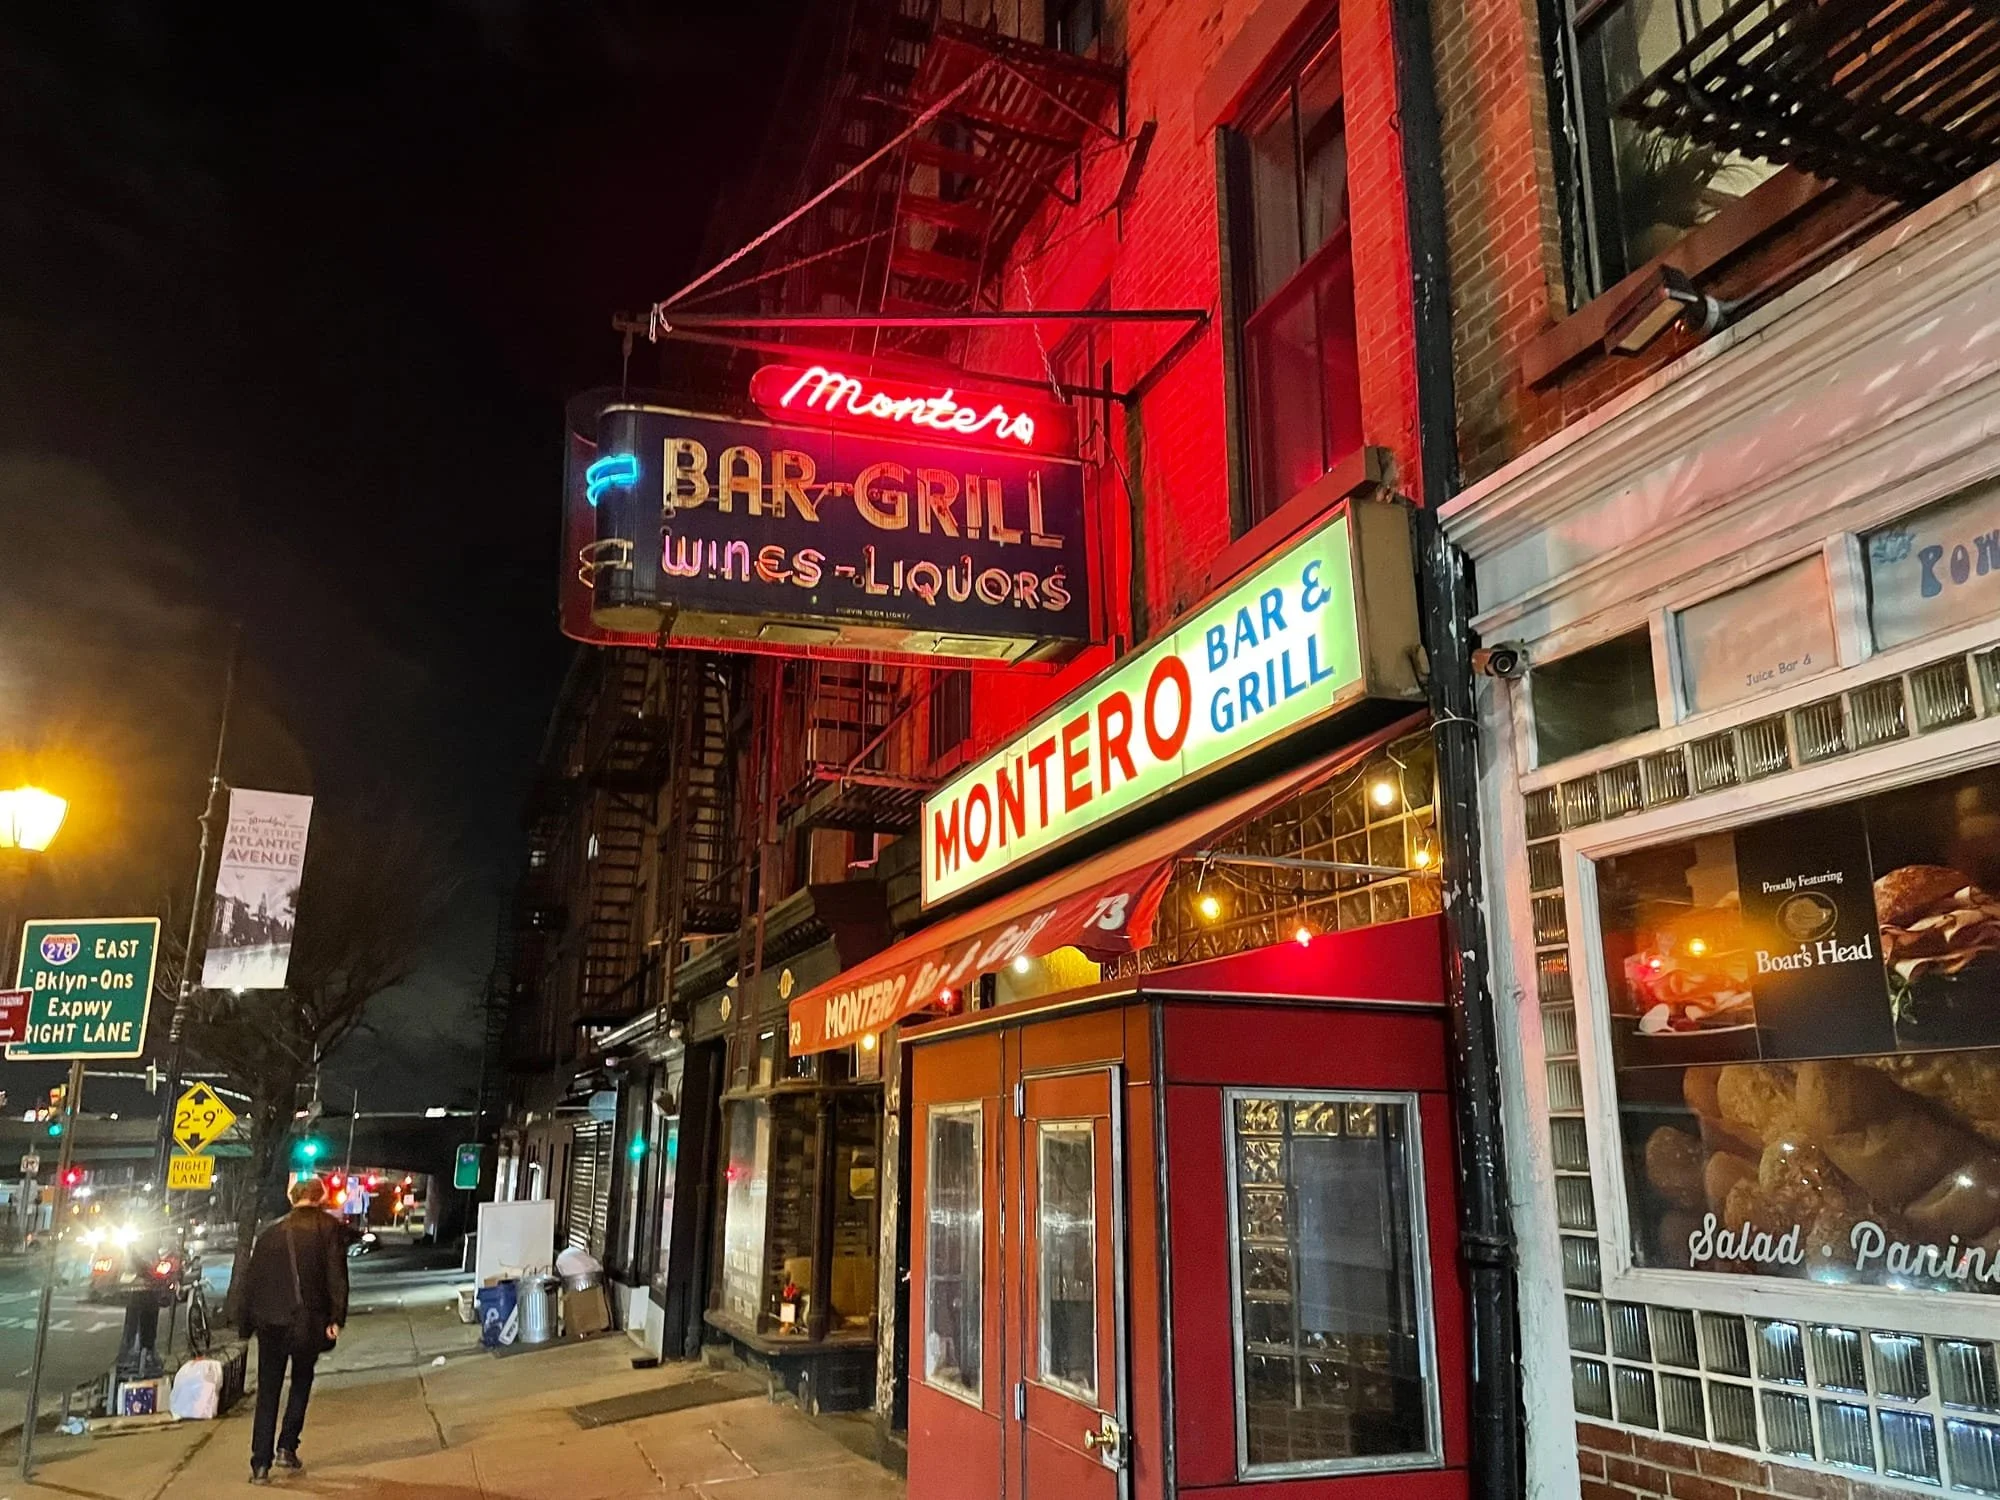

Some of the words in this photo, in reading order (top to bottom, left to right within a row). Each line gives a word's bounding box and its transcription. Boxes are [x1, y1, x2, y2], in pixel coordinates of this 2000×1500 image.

[780, 366, 1035, 444] Montero
[864, 544, 1071, 611] LIQUORS
[1205, 588, 1288, 673] BAR
[1302, 560, 1332, 612] &
[1210, 634, 1335, 733] GRILL
[1746, 670, 1774, 686] Juice
[1778, 660, 1798, 674] Bar
[934, 655, 1192, 882] MONTERO
[228, 835, 302, 852] ATLANTIC
[226, 848, 300, 867] AVENUE
[1762, 877, 1797, 893] Proudly
[1798, 870, 1843, 886] Featuring
[47, 943, 73, 959] 278
[95, 938, 139, 959] EAST
[1755, 944, 1813, 974] Boar's
[1815, 933, 1873, 965] Head
[825, 975, 907, 1040] MONTERO
[1083, 893, 1130, 930] 73
[35, 969, 134, 995] Bklyn-Qns
[48, 997, 112, 1020] Expwy
[26, 1023, 77, 1043] RIGHT
[83, 1021, 133, 1043] LANE
[173, 1160, 208, 1171] RIGHT
[172, 1173, 206, 1185] LANE
[1688, 1212, 1804, 1268] Salad
